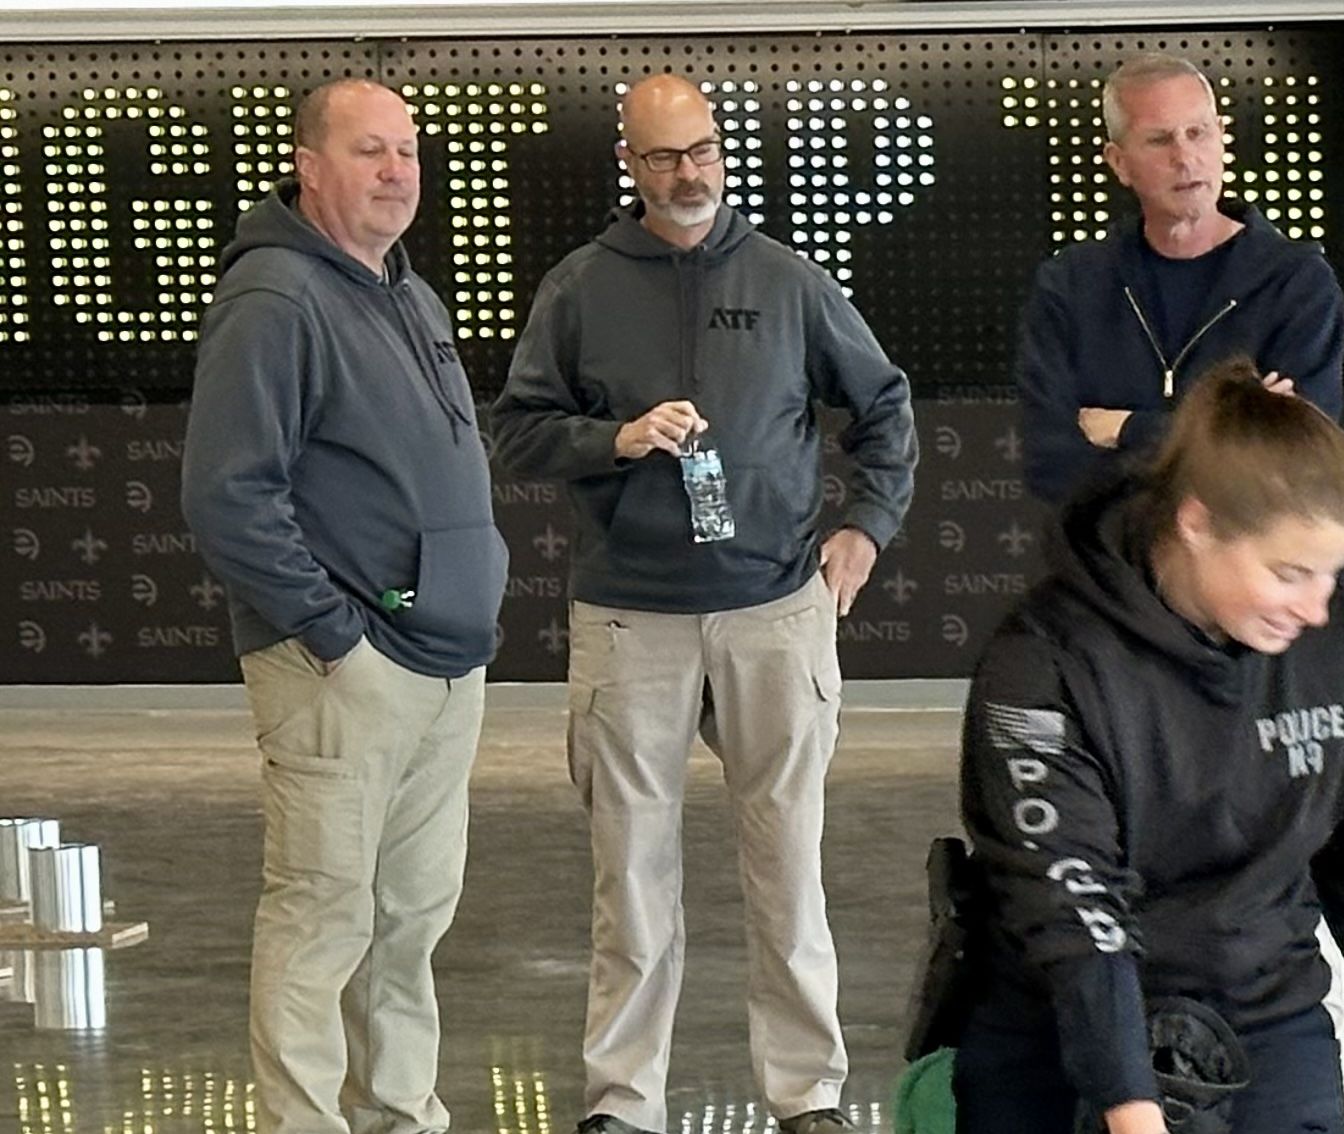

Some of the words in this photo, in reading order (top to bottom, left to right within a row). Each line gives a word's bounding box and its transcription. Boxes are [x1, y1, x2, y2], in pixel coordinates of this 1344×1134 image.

[706, 307, 761, 331] ATF
[126, 440, 182, 461] SAIN
[15, 487, 95, 508] SAINTS
[493, 482, 557, 503] AINTS
[941, 480, 1022, 501] SAINTS
[132, 533, 197, 553] SAINT
[20, 580, 101, 601] SAINTS
[944, 573, 1025, 594] SAINTS
[138, 626, 219, 647] SAINTS
[839, 620, 911, 641] AINTS
[1288, 740, 1325, 778] K9
